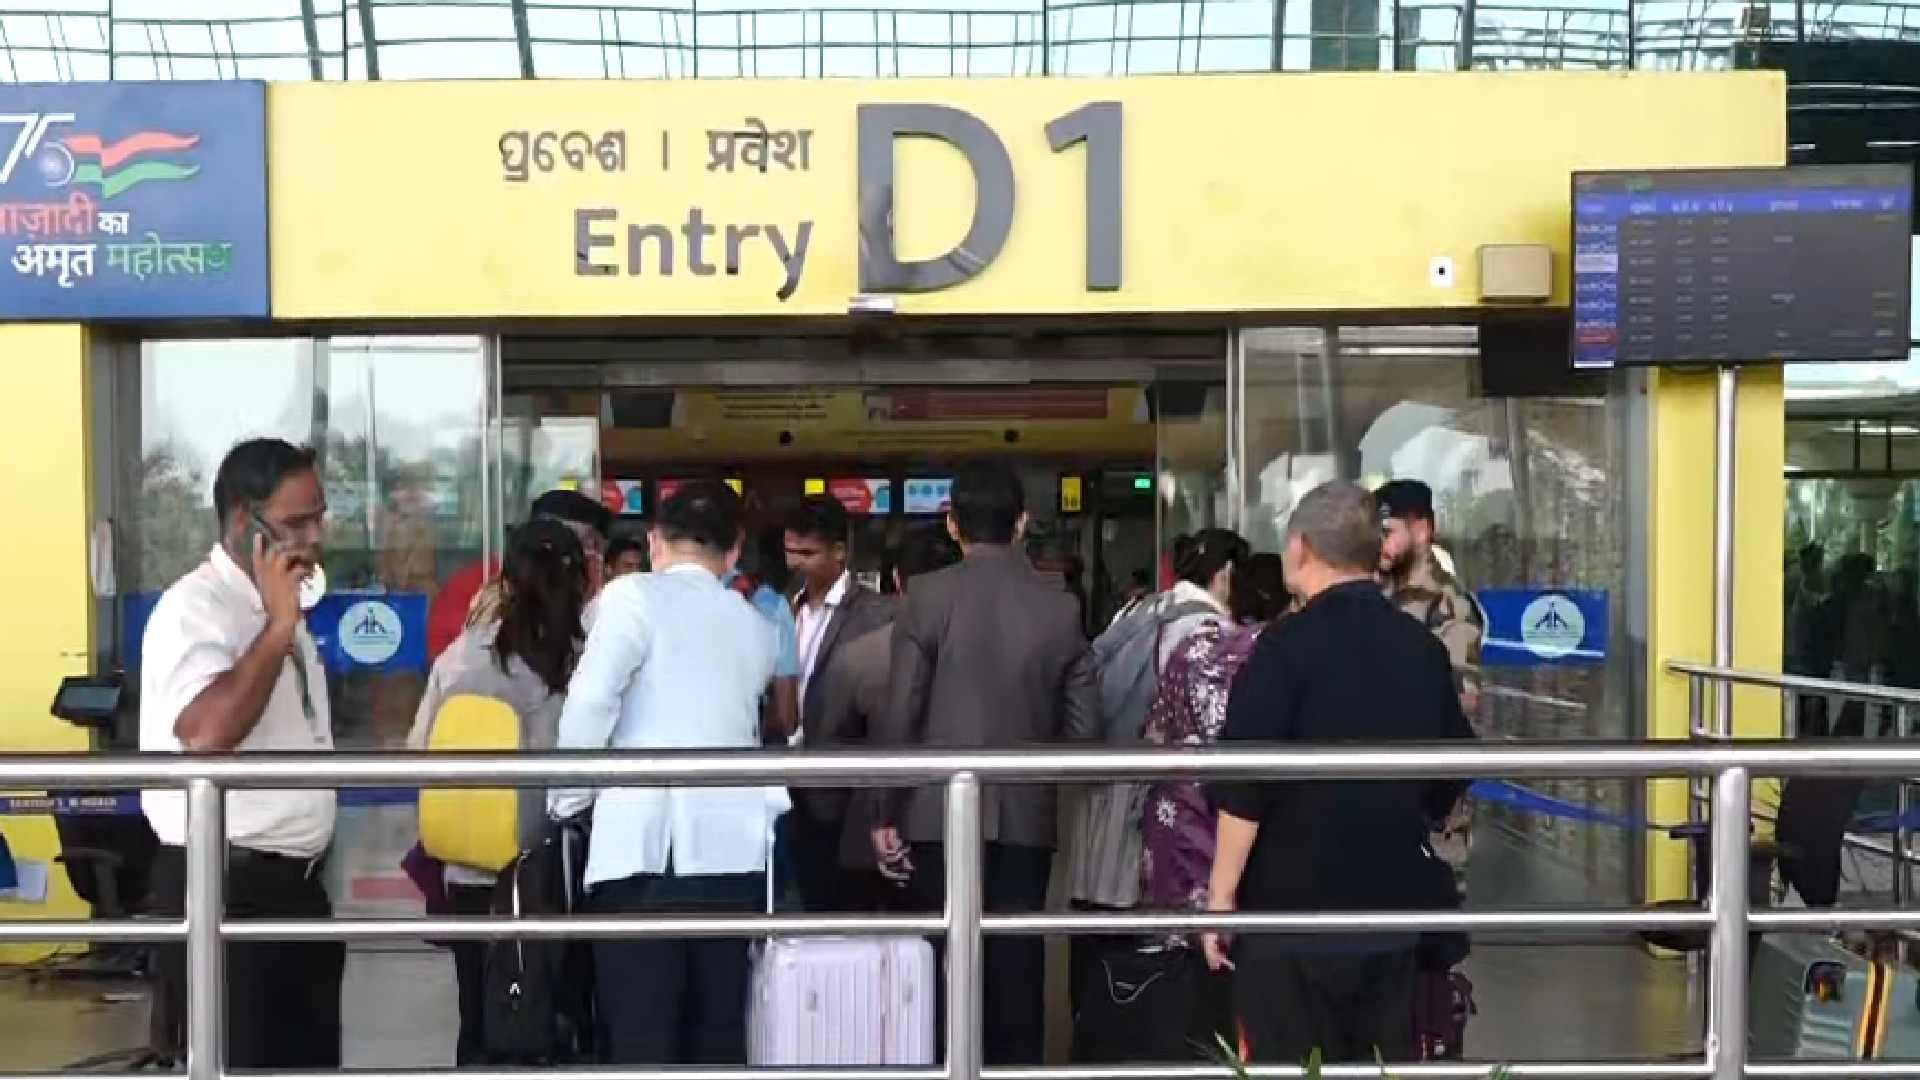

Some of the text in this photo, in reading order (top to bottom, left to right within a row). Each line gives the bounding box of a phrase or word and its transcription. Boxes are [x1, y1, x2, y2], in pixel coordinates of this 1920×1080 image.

[705, 117, 813, 173] प्रवेश
[97, 212, 130, 235] का
[857, 102, 1122, 293] D1
[11, 243, 97, 288] अमृत
[574, 208, 812, 299] Entry
